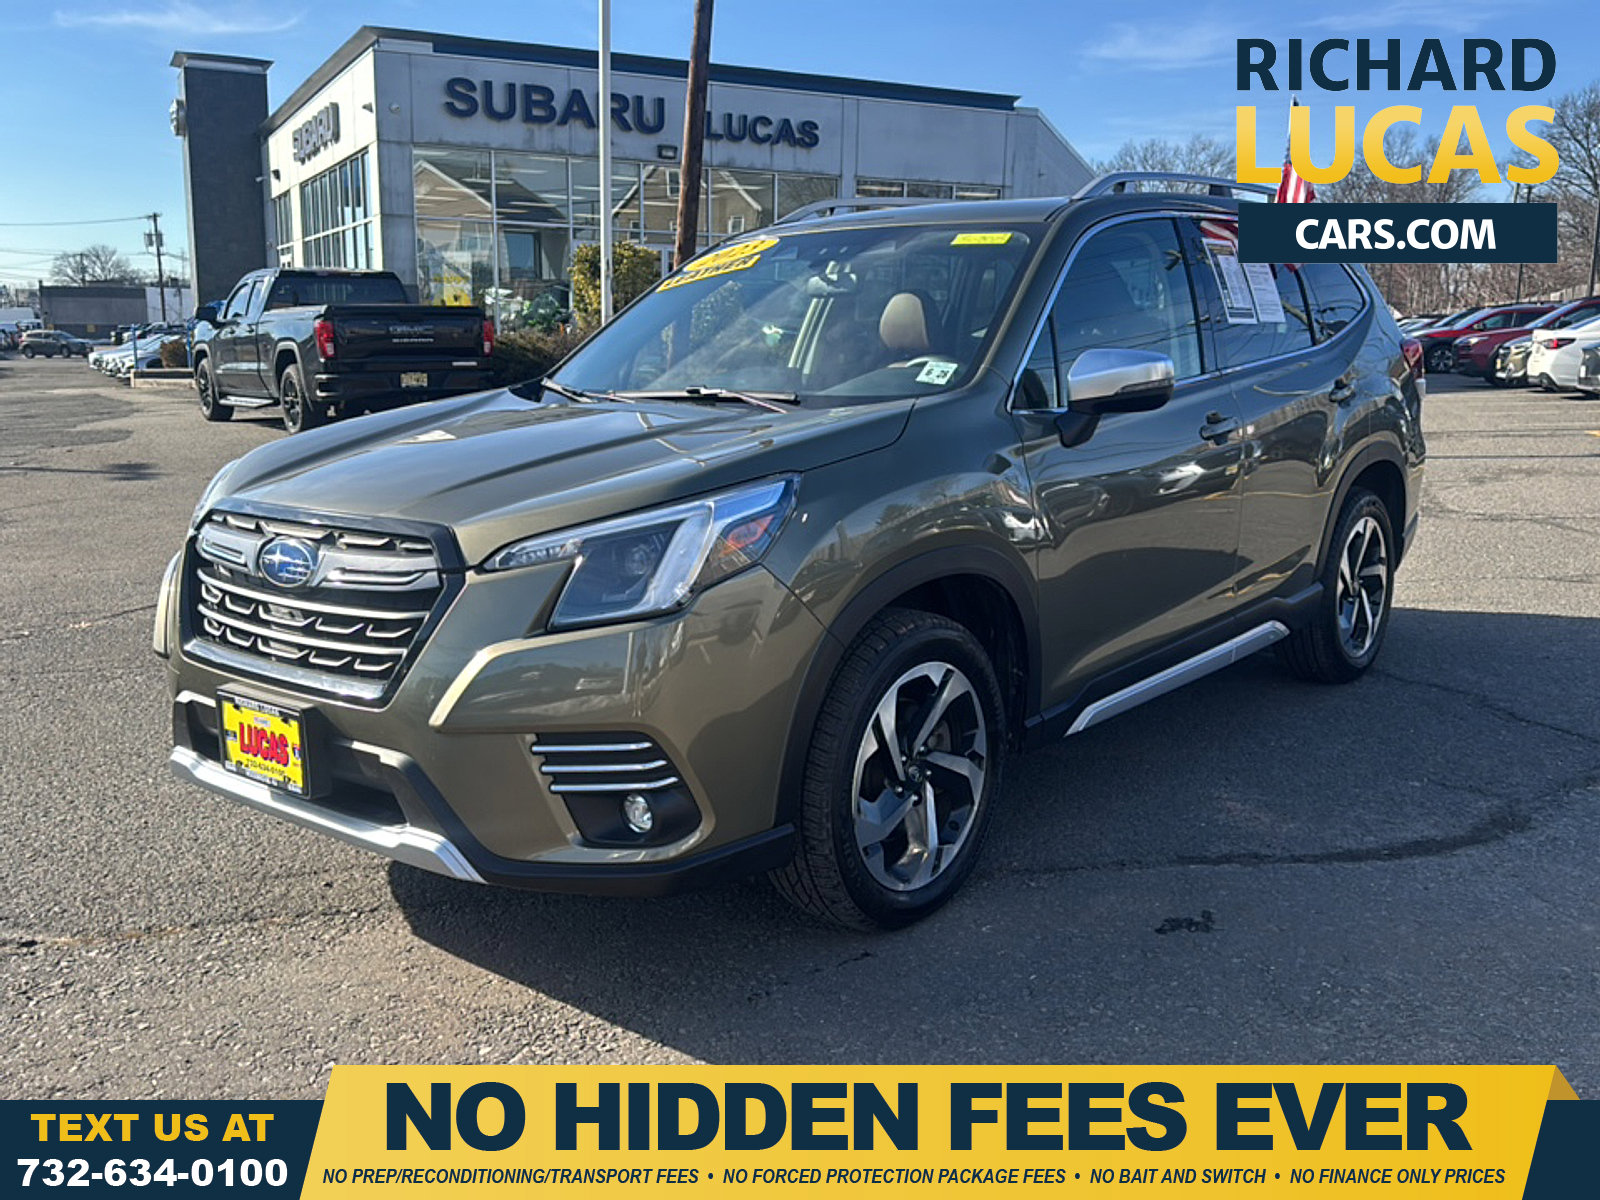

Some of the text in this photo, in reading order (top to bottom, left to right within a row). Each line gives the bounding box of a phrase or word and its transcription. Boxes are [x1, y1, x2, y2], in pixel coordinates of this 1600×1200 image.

[443, 76, 666, 135] SUBARU
[705, 109, 821, 149] LUCAS
[292, 102, 341, 165] SUBARU
[239, 721, 290, 768] LUCAS
